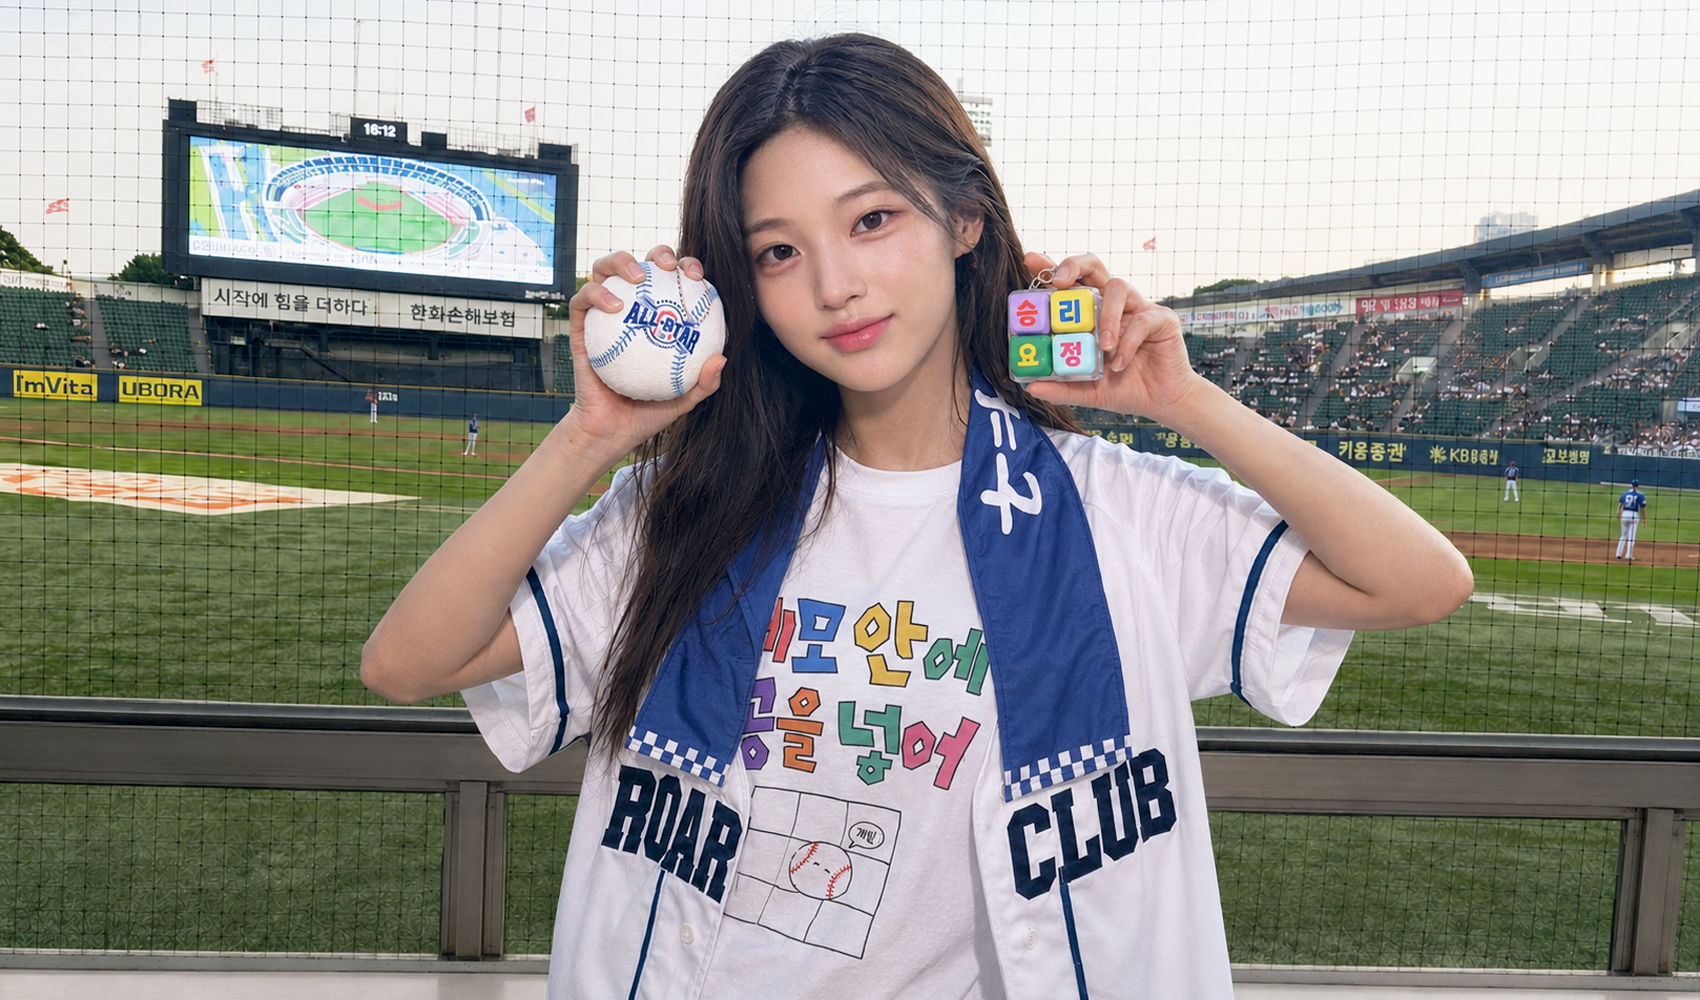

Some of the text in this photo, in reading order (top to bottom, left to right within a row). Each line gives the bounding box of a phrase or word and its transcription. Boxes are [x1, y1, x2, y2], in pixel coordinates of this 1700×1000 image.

[363, 122, 397, 138] 16:12
[214, 288, 368, 316] 시작에 힘을 더하다
[410, 303, 516, 328] 한화손해보험
[623, 301, 660, 327] ALL
[1016, 299, 1081, 327] 승리
[1017, 341, 1082, 368] 요정
[121, 381, 200, 400] UBORA
[853, 600, 990, 696] 안에
[740, 676, 981, 790] 공을 넣어
[600, 764, 743, 904] ROAR
[1006, 747, 1177, 901] CLUB
